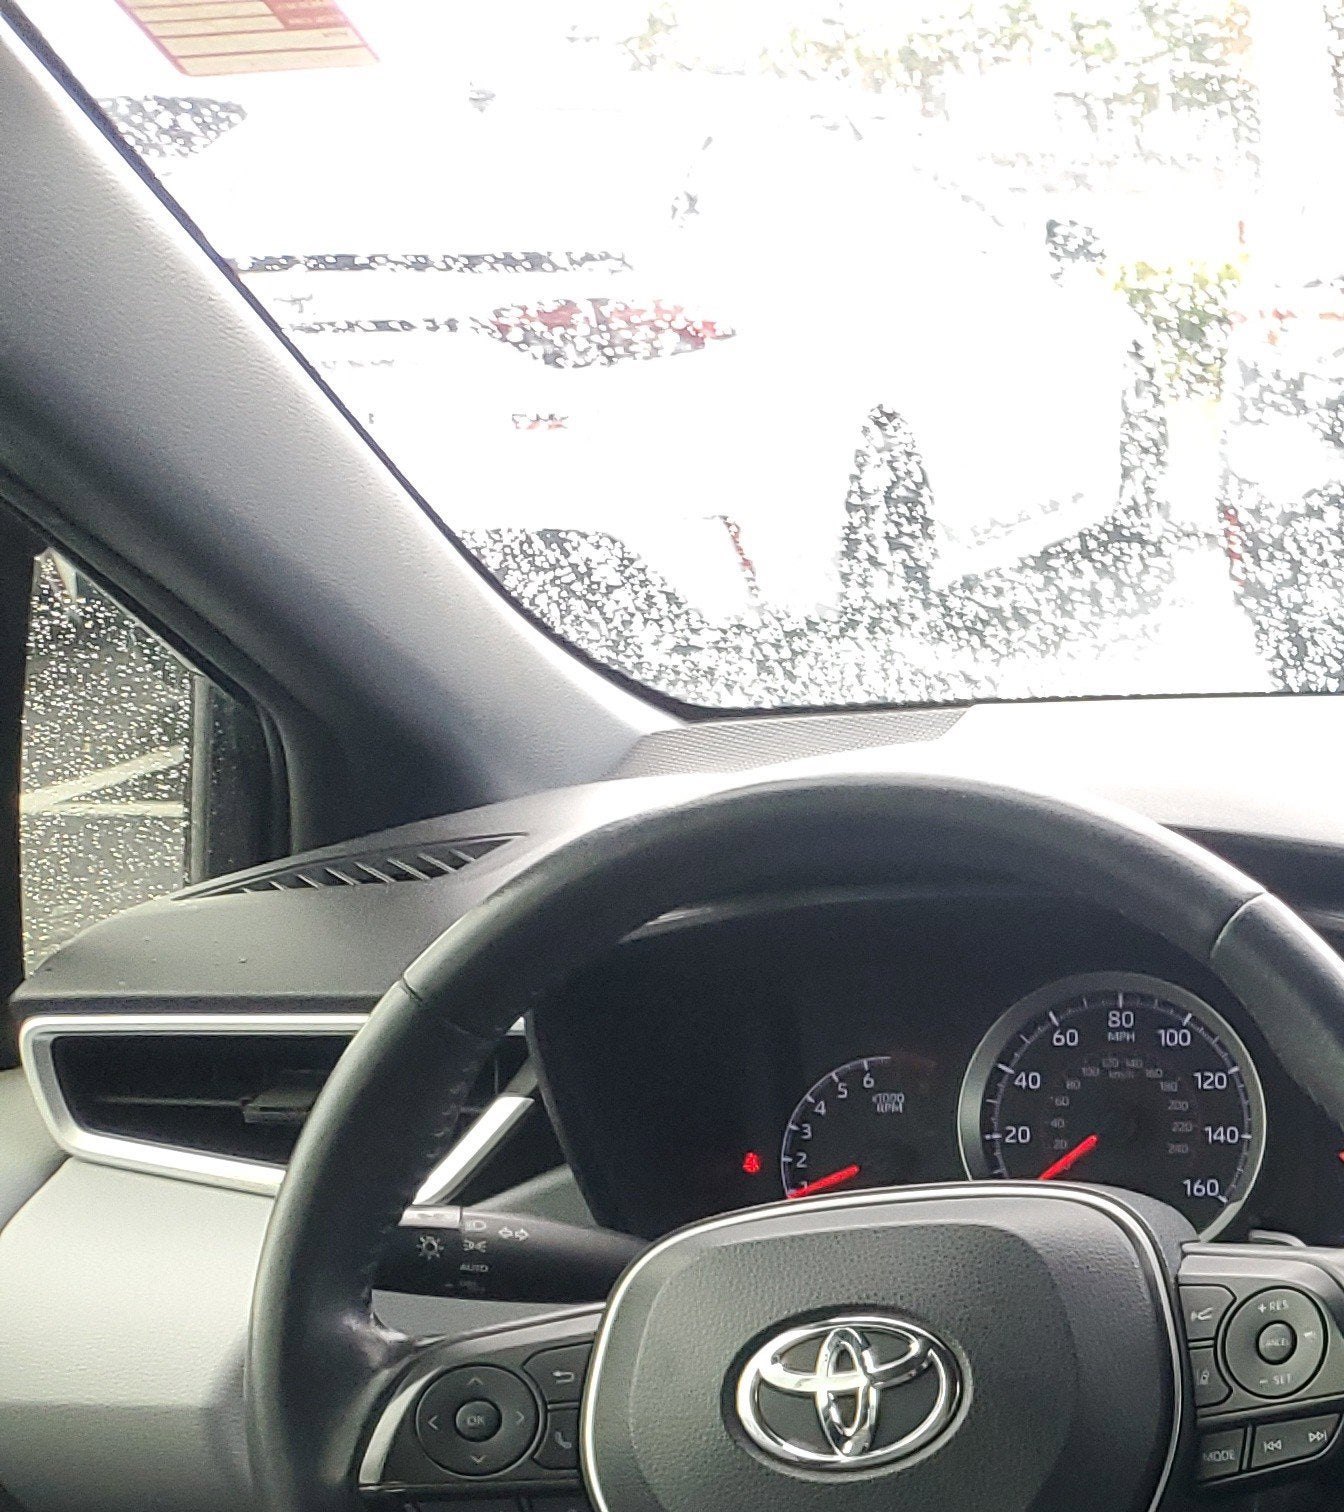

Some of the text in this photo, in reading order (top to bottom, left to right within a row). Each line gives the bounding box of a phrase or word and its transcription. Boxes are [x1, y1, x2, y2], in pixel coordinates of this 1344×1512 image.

[1107, 1010, 1135, 1028] 80
[1052, 1029, 1079, 1047] 60
[1107, 1031, 1136, 1043] MPH
[1157, 1028, 1192, 1047] 100
[862, 1072, 875, 1089] 6
[1013, 1071, 1041, 1090] 40
[1192, 1071, 1227, 1090] 120
[837, 1082, 848, 1099] 5
[813, 1099, 827, 1116] 4
[876, 1102, 903, 1114] RPM
[1054, 1096, 1070, 1107] 60
[800, 1122, 813, 1140] 3
[1004, 1125, 1031, 1144] 20
[1204, 1125, 1240, 1144] 140
[795, 1151, 808, 1169] 2
[1183, 1178, 1220, 1197] 160
[459, 1263, 490, 1273] AUTO
[466, 1414, 485, 1427] OK
